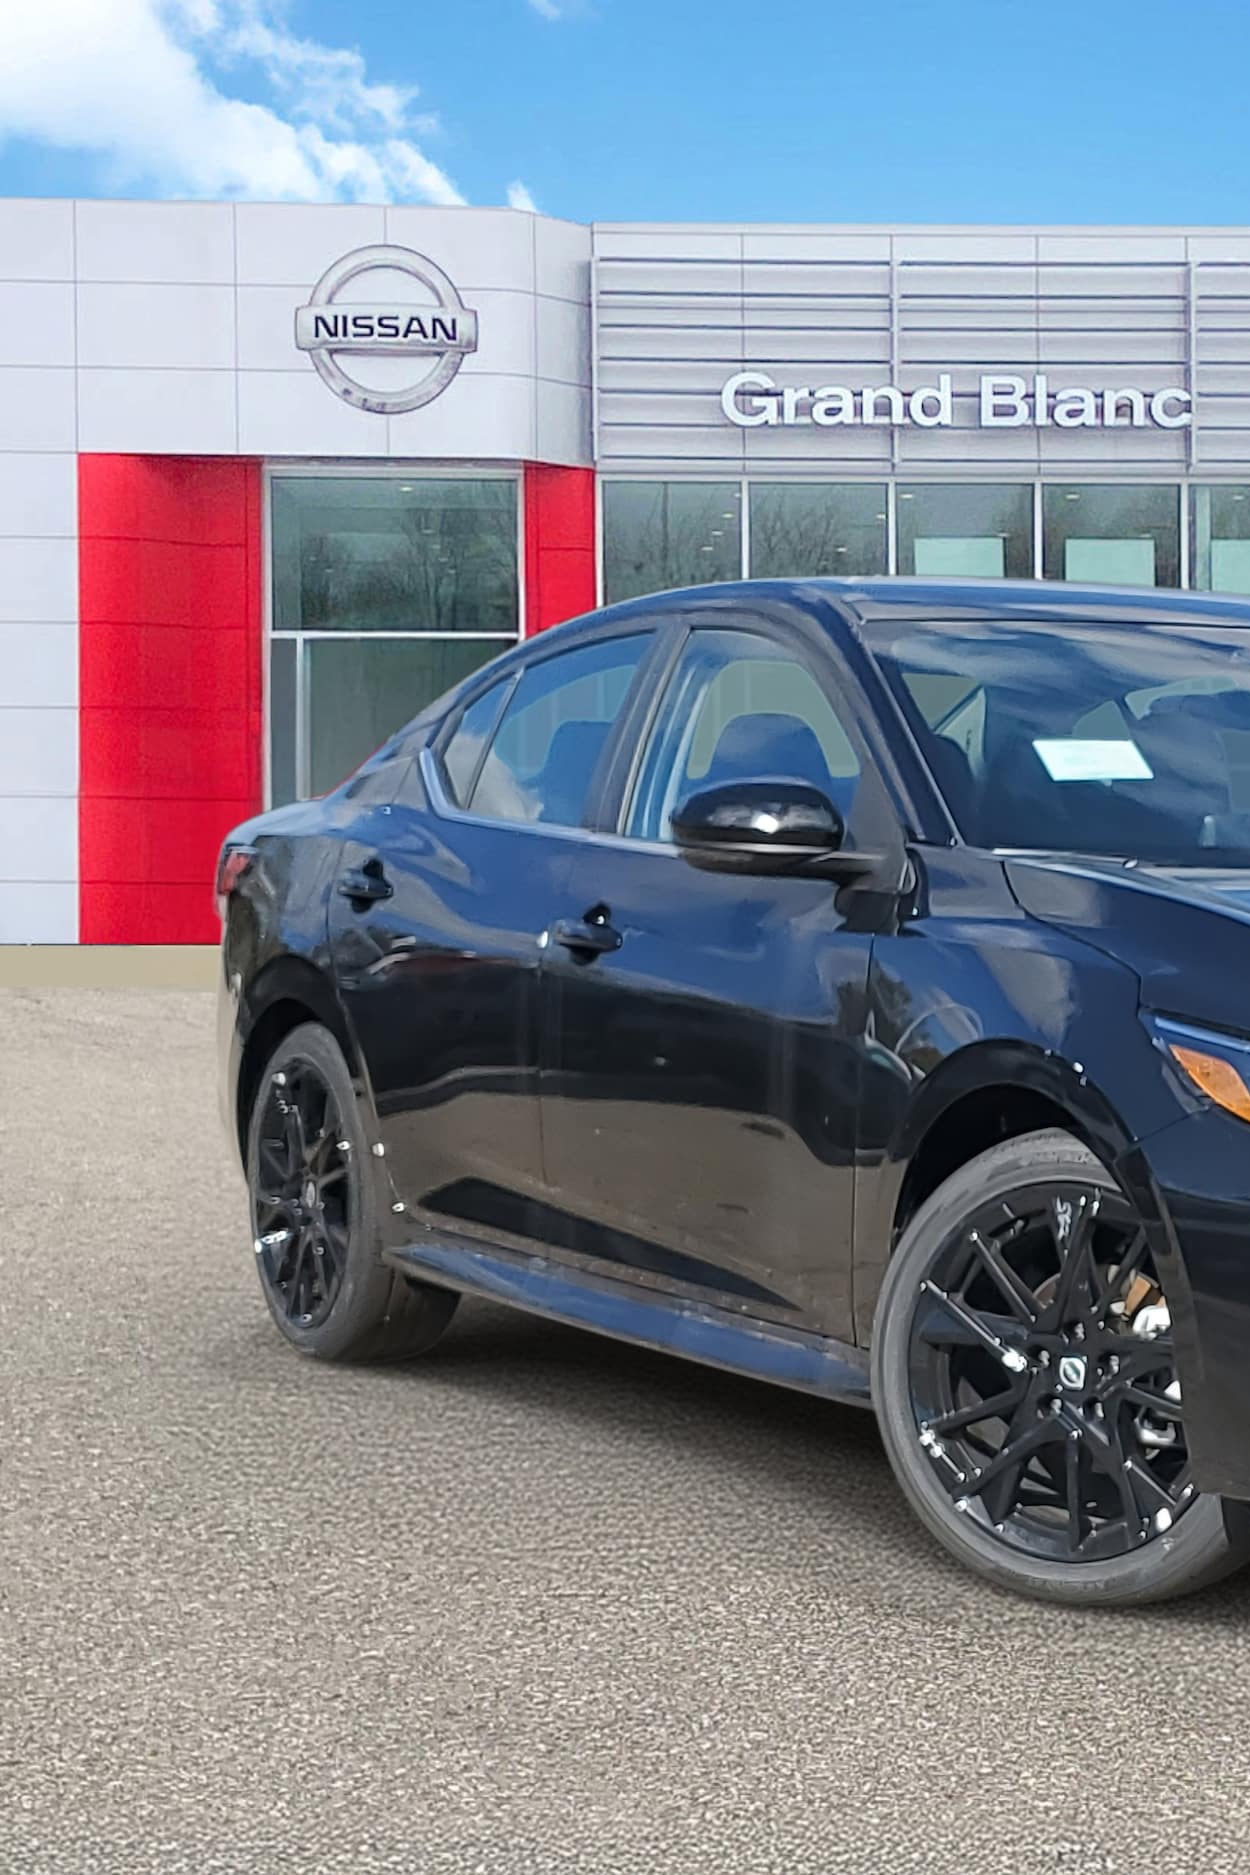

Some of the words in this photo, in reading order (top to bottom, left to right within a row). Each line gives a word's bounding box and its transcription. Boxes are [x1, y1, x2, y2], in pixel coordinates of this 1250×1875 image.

[314, 315, 458, 341] NISSAN
[720, 371, 951, 428] Grand
[979, 373, 1193, 429] Blanc
